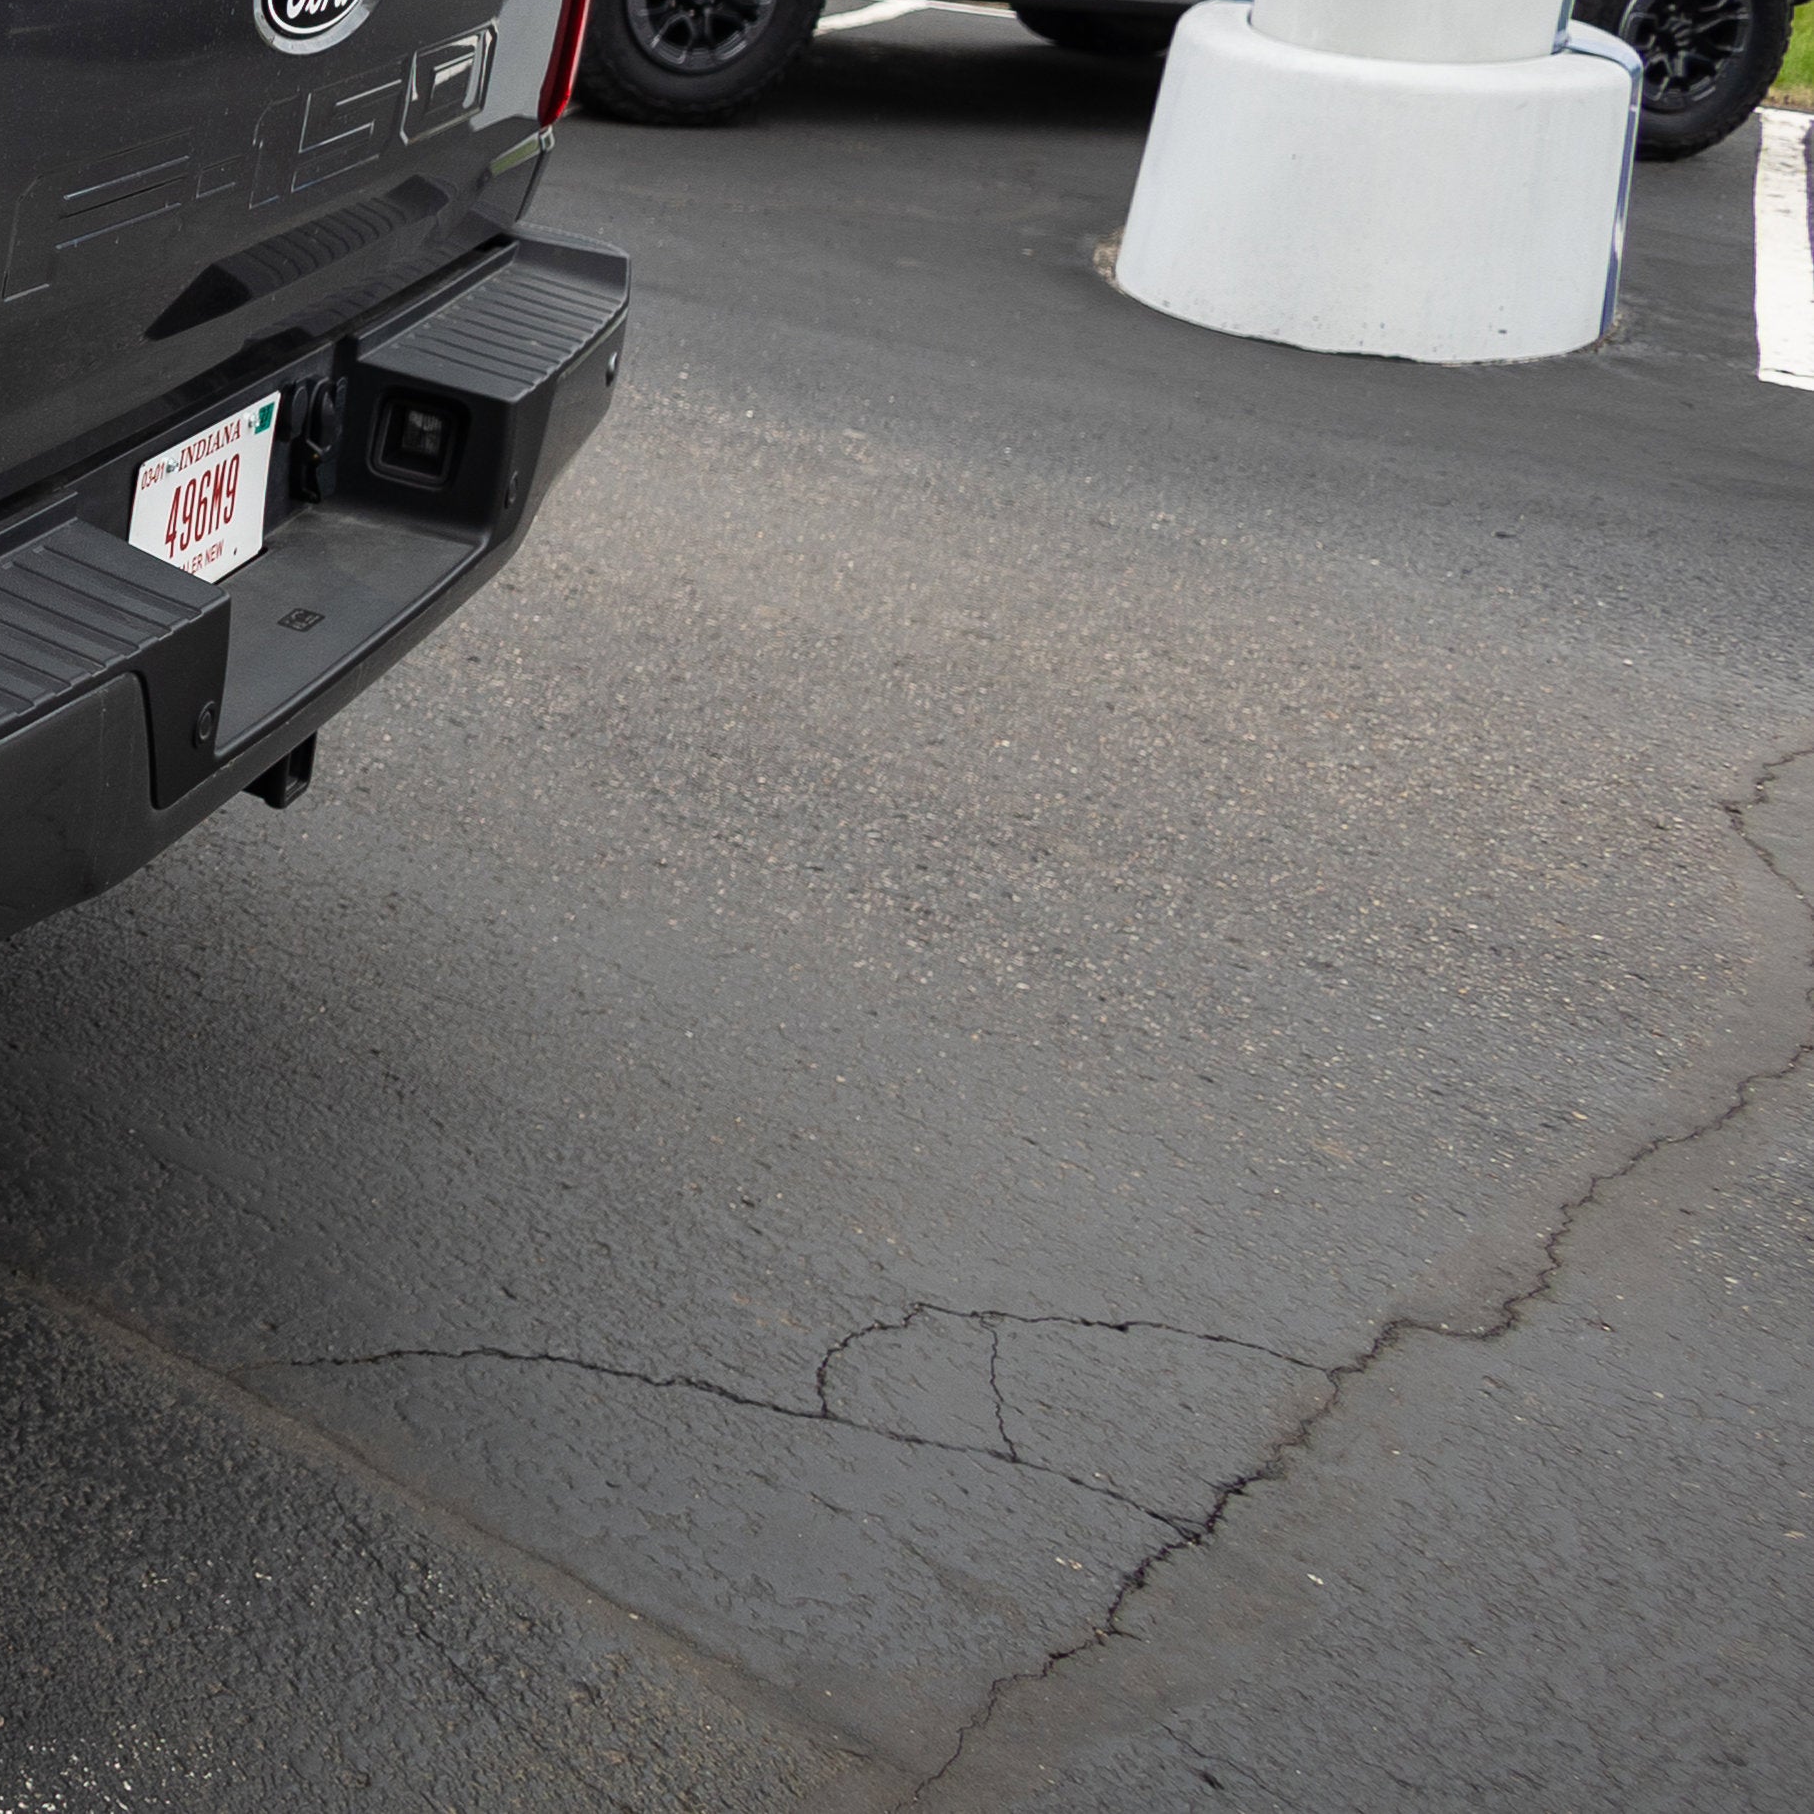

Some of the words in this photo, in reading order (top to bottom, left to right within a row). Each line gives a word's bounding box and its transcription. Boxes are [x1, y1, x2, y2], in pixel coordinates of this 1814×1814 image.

[177, 419, 242, 473] INDIANA
[164, 452, 241, 560] 496M9
[205, 539, 225, 564] NEW
